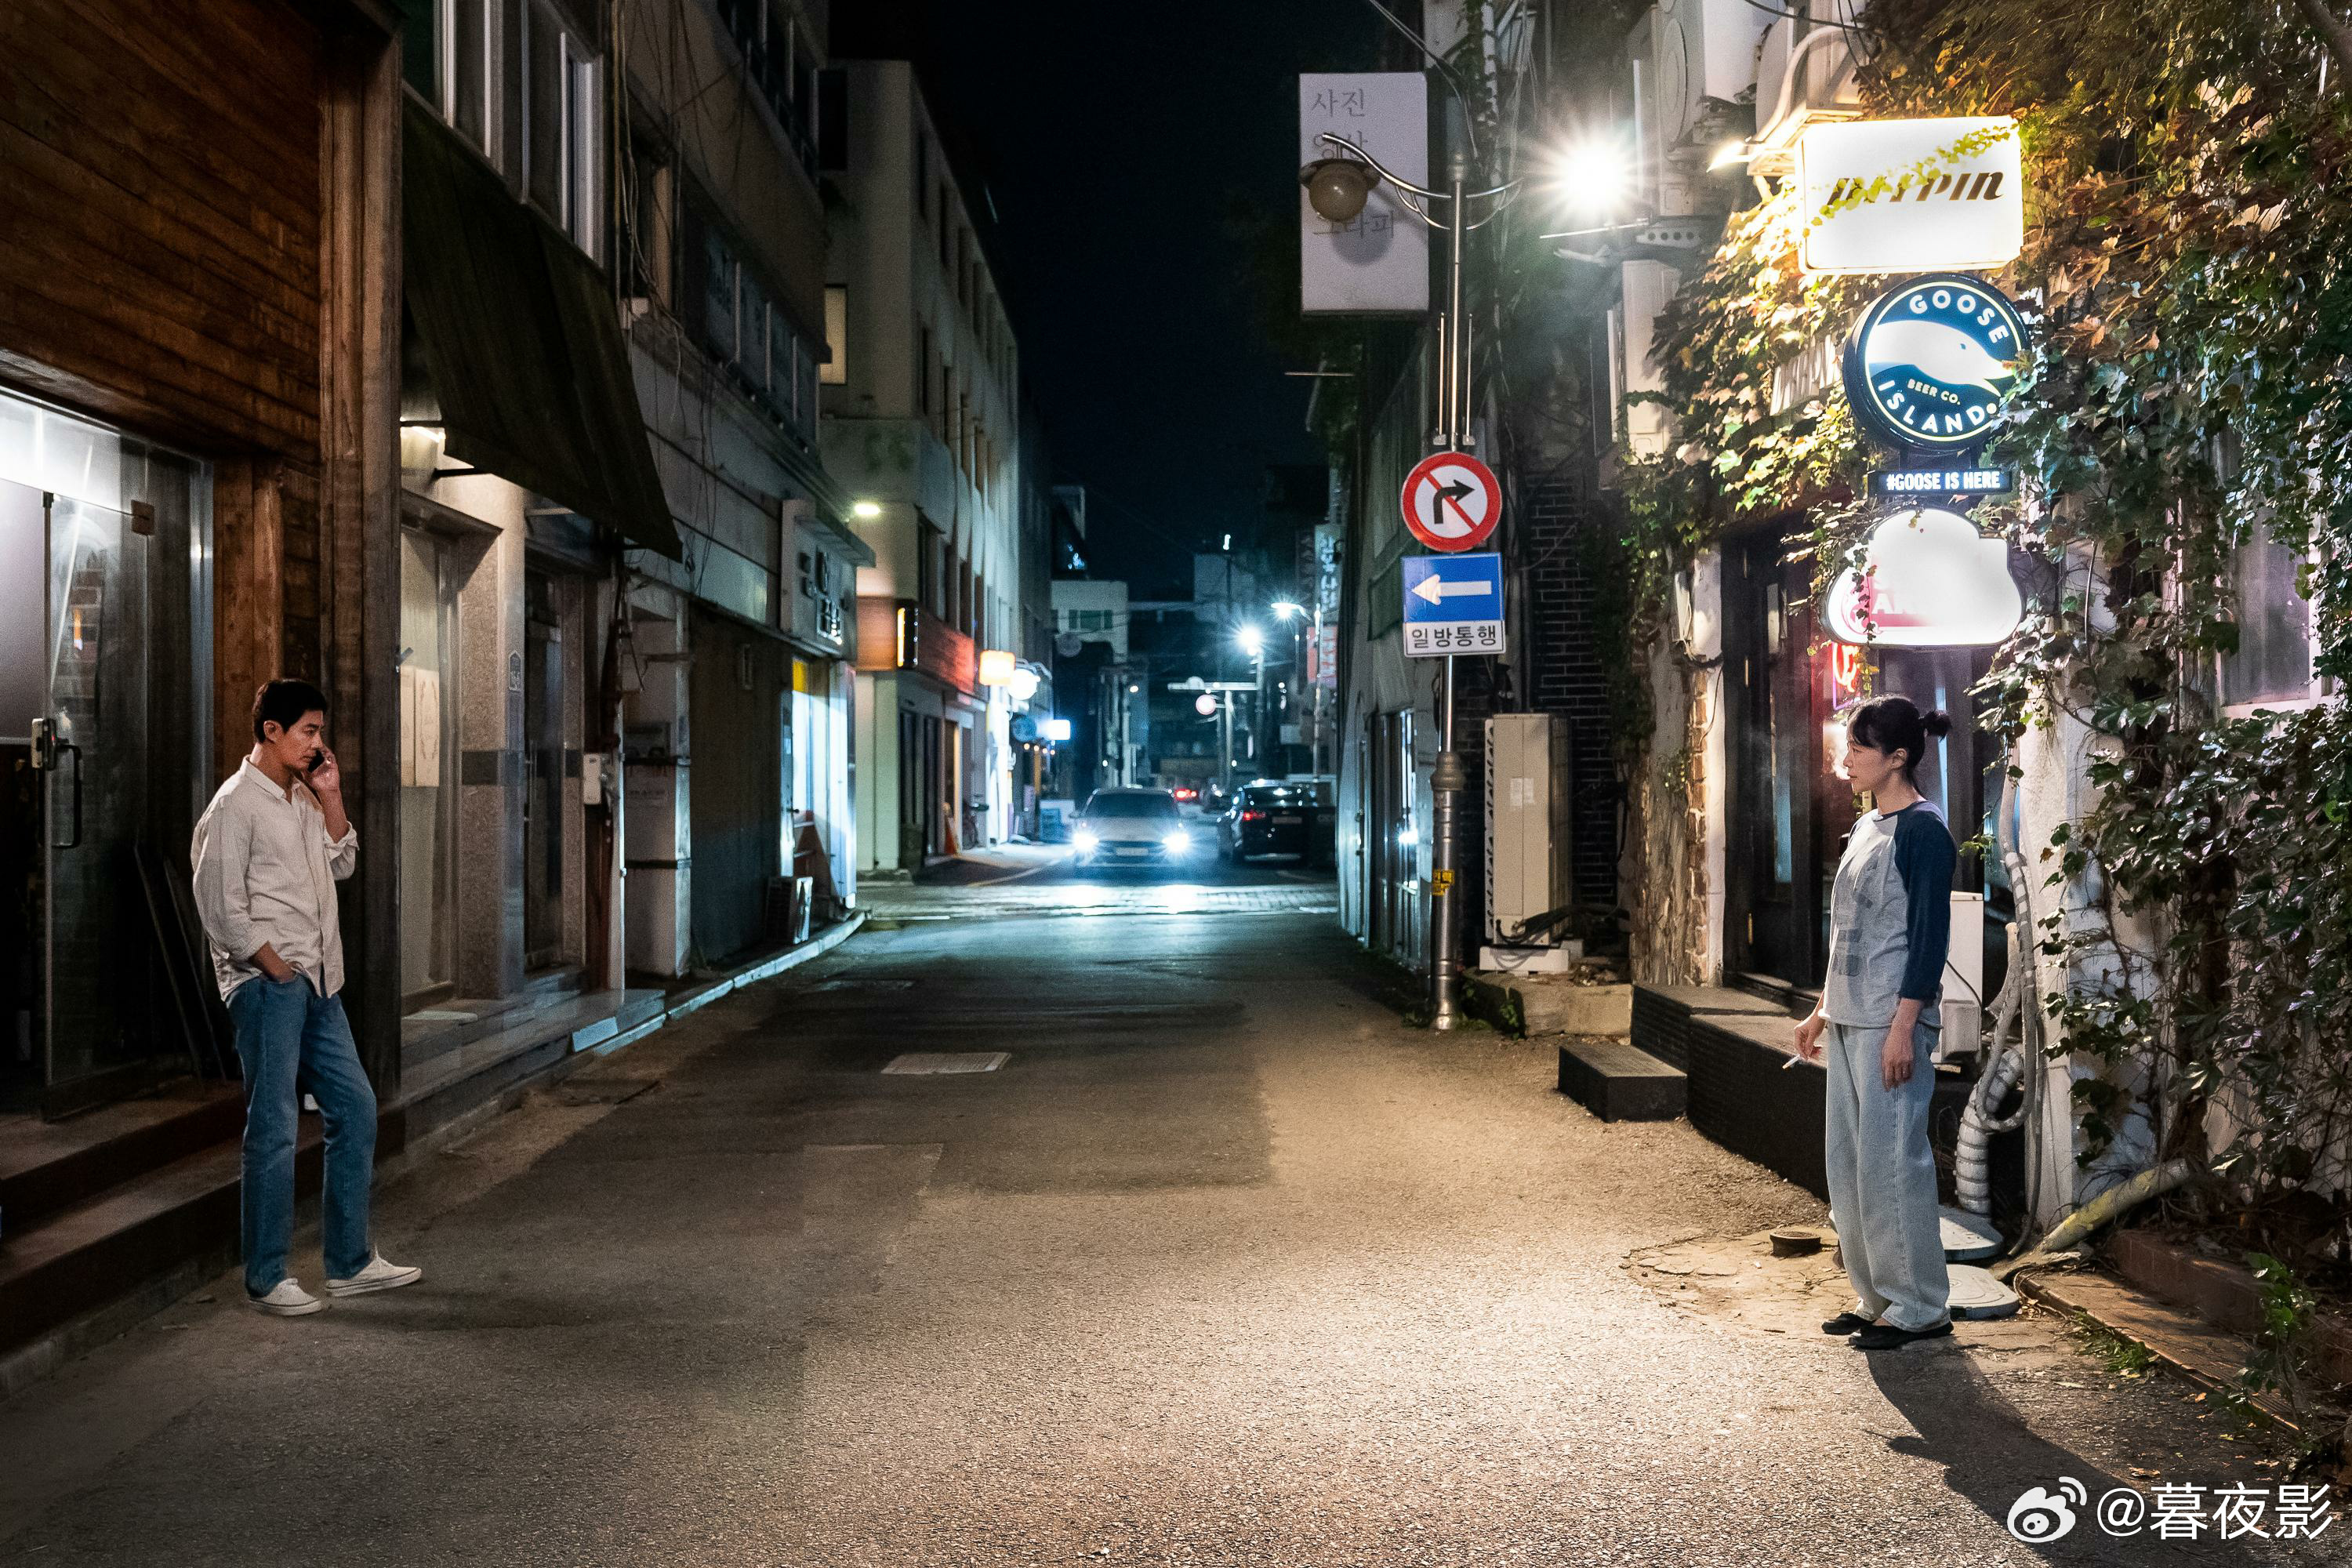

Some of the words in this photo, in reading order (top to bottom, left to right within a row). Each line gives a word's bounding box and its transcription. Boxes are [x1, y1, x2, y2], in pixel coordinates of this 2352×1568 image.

[1312, 89, 1365, 117] 사진
[1909, 289, 2009, 343] GOOSE
[1907, 378, 1938, 397] BEER
[1940, 390, 1961, 405] CO.
[1878, 379, 1986, 434] ISLAND
[1886, 473, 1941, 491] #GOOSE
[1945, 472, 1960, 490] IS
[1963, 470, 2001, 489] HERE
[1412, 626, 1496, 648] 일방통행
